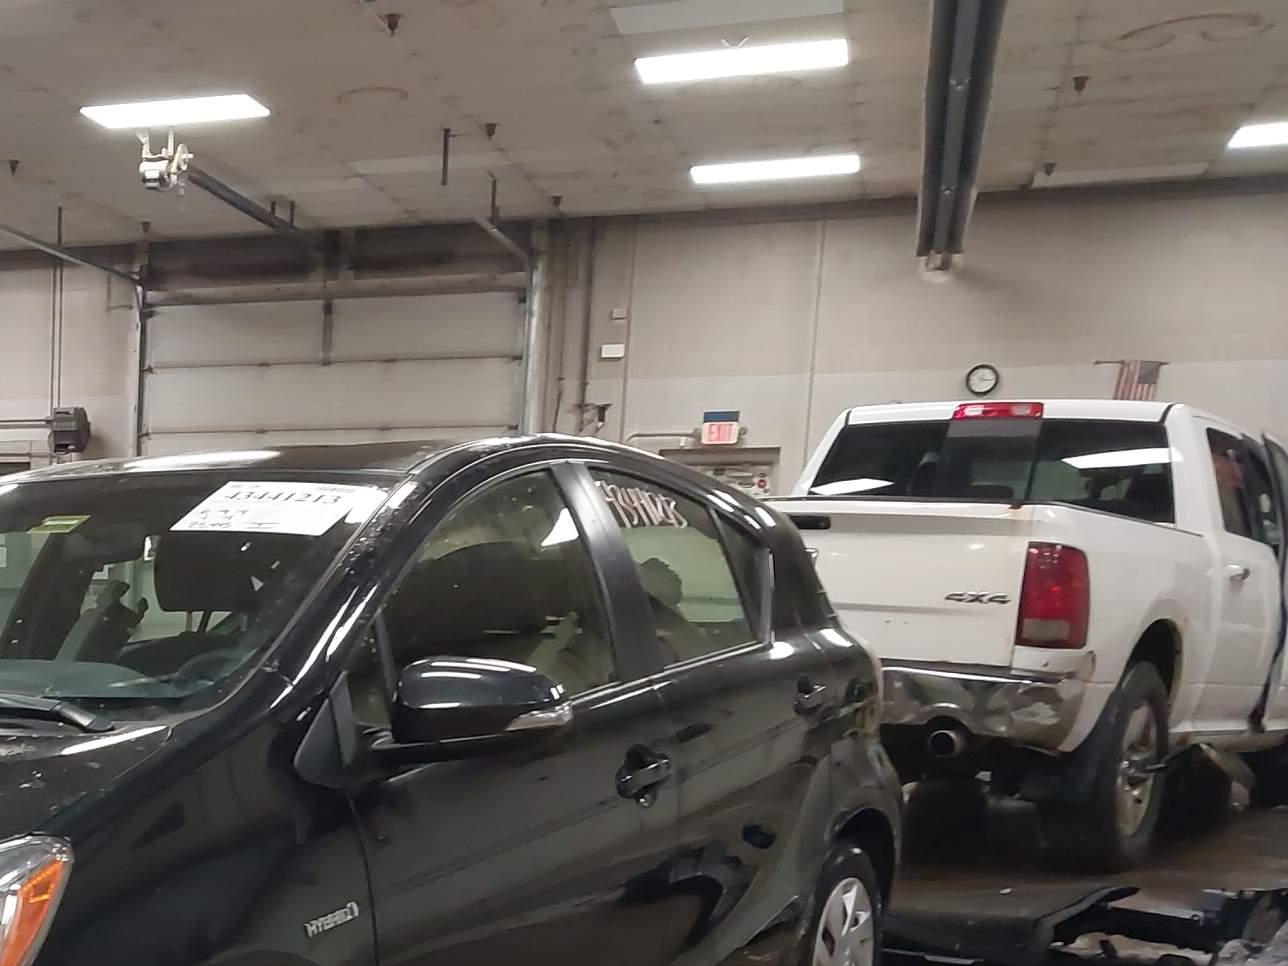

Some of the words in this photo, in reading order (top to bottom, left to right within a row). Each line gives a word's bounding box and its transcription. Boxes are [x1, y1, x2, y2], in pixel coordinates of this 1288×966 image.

[708, 423, 733, 441] EXIT
[223, 491, 342, 504] 43441213
[303, 901, 360, 938] HYBRID
